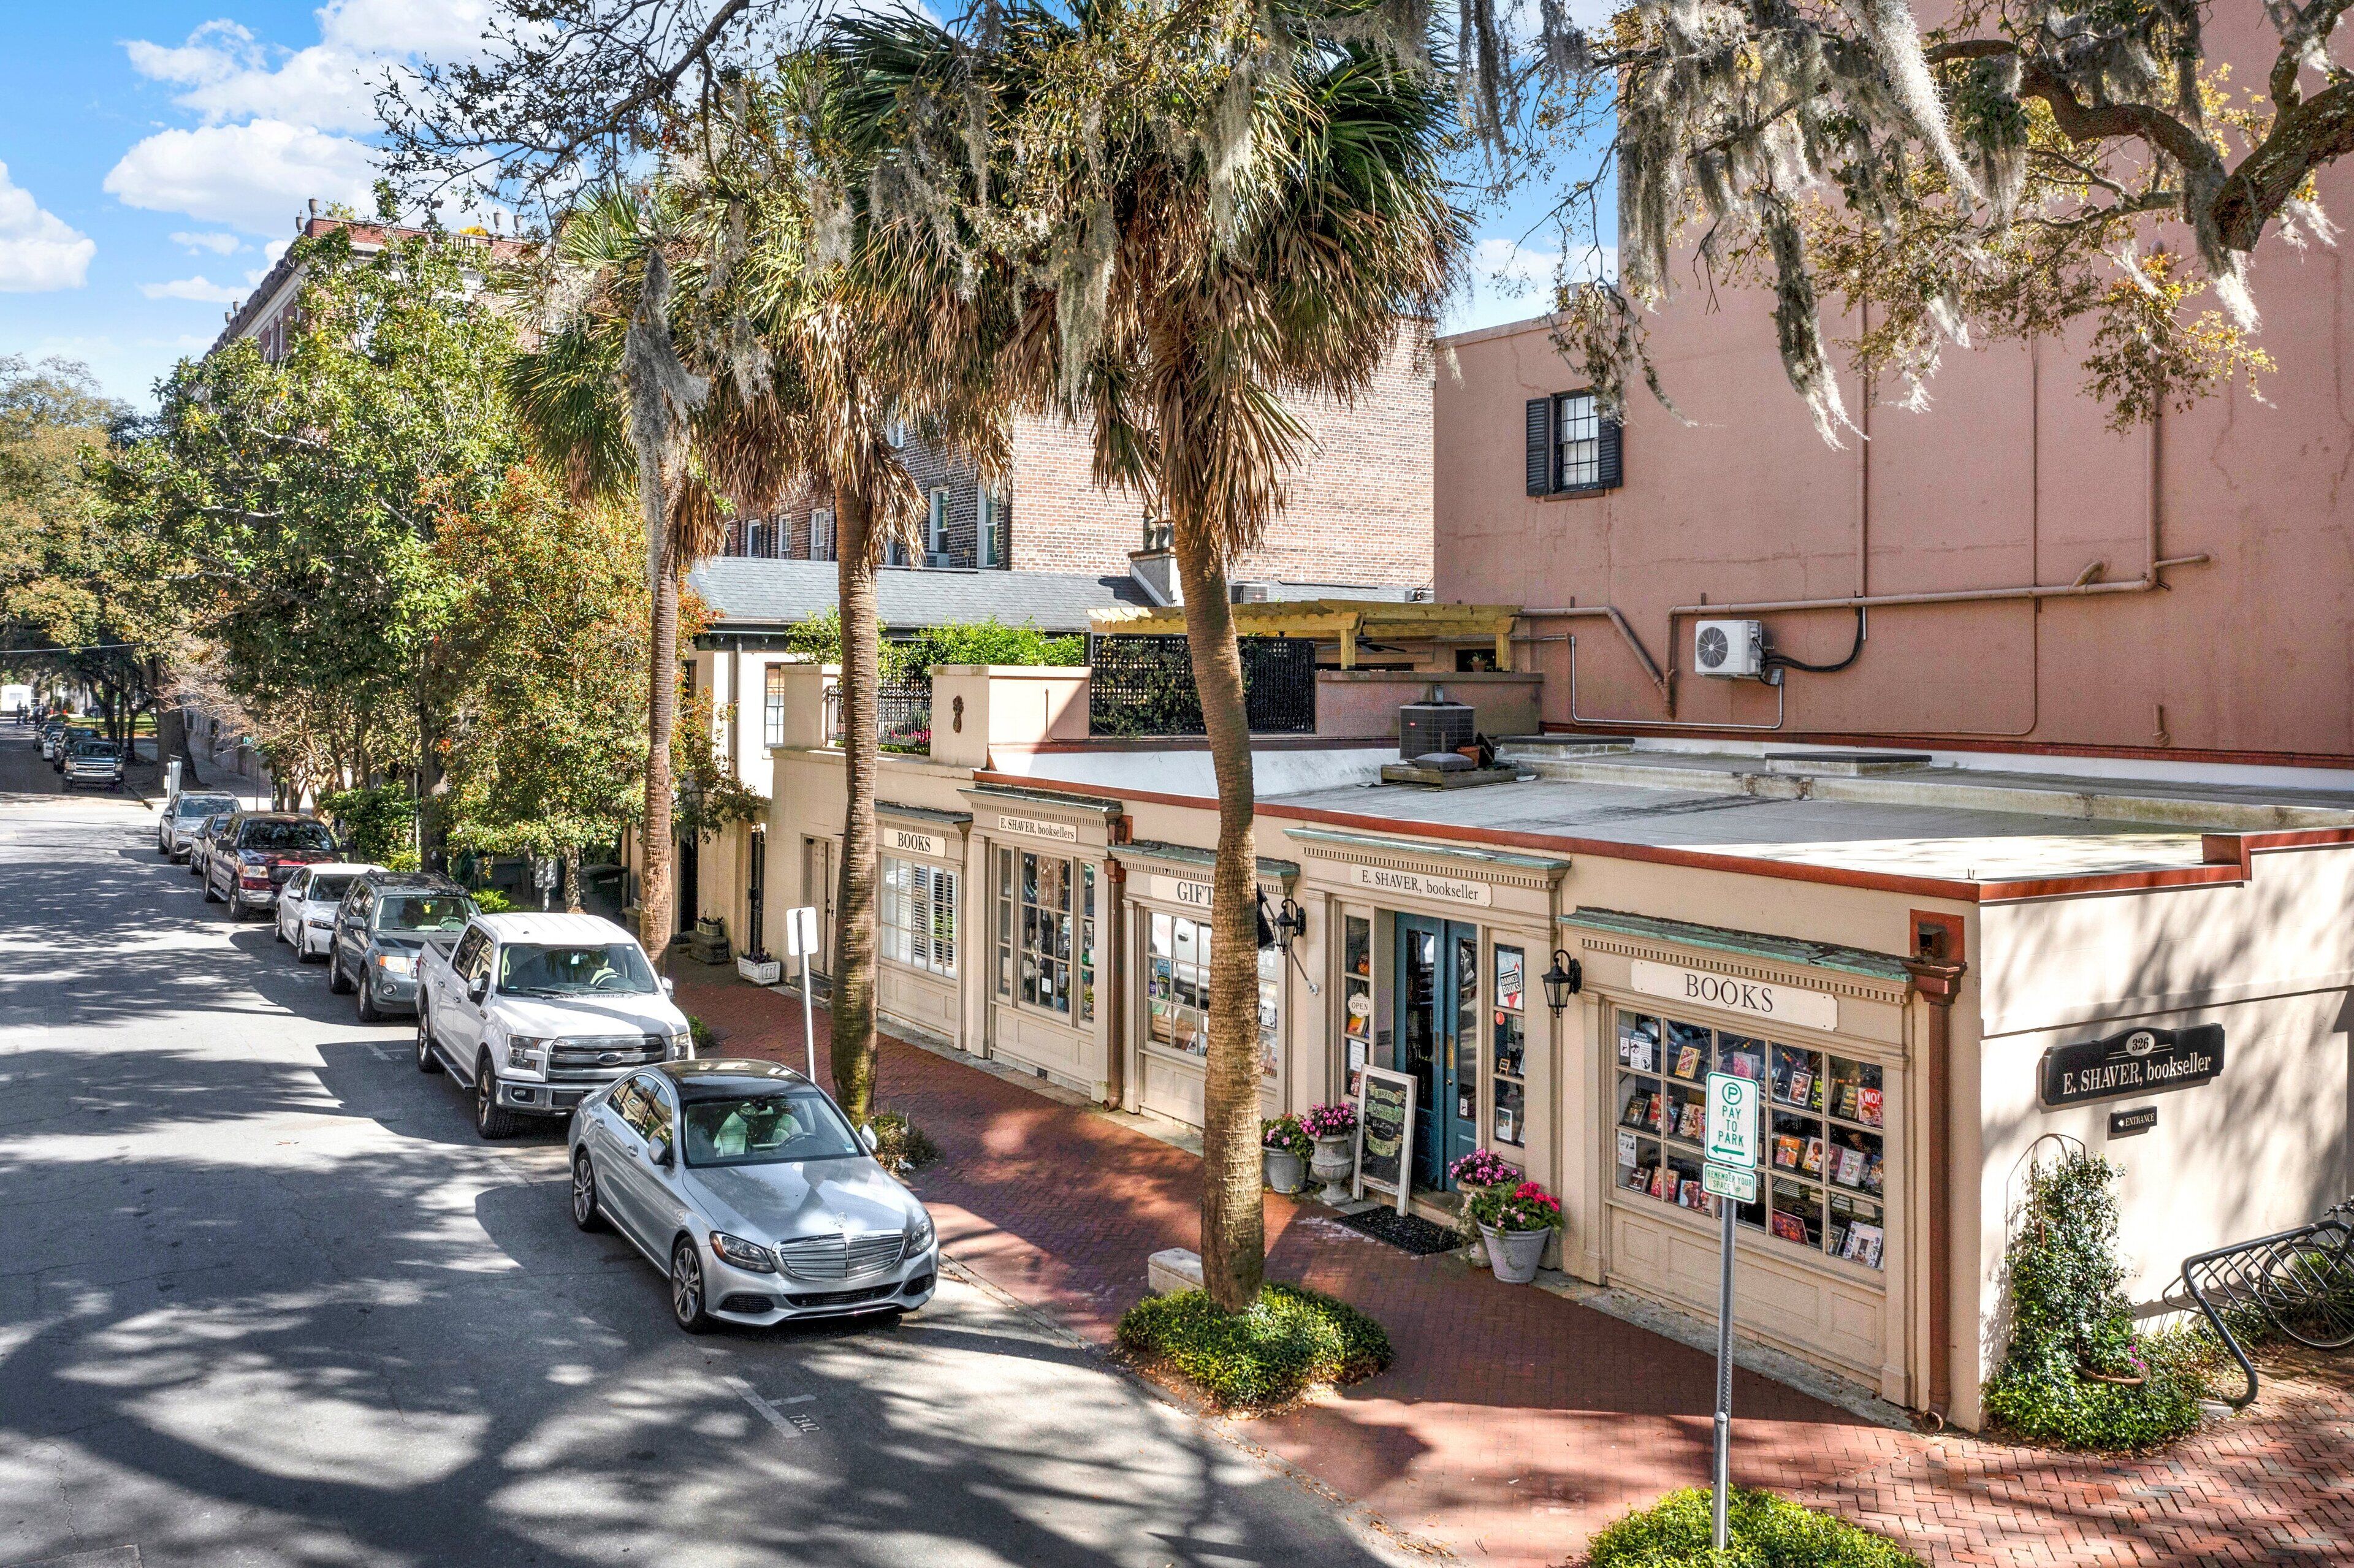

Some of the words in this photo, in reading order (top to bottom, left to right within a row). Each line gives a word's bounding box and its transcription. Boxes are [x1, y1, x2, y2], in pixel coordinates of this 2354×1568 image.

[1000, 818, 1007, 828] E.
[1008, 819, 1036, 834] SHAVER,
[1038, 823, 1074, 839] booksellers
[897, 832, 931, 853] BOOKS
[1362, 869, 1371, 883] E.
[1375, 872, 1422, 894] SHAVER,
[1426, 879, 1479, 900] bookseller
[1501, 974, 1518, 986] BANNED
[1503, 982, 1520, 995] BOOKS
[1685, 973, 1773, 1013] BOOKS
[1352, 1002, 1368, 1010] OPEN
[2132, 1037, 2149, 1051] 326
[2063, 1073, 2076, 1095] E.
[2081, 1062, 2143, 1092] SHAVER,
[2147, 1052, 2211, 1081] bookseller
[1864, 1091, 1880, 1105] NO!
[1722, 1105, 1741, 1120] PAY
[1726, 1119, 1737, 1132] TO
[2125, 1113, 2155, 1127] ENTRANCE
[1718, 1130, 1744, 1147] PARK
[1707, 1170, 1735, 1183] REMEMBER
[1737, 1176, 1752, 1187] YOUR
[1713, 1180, 1730, 1190] SPACE
